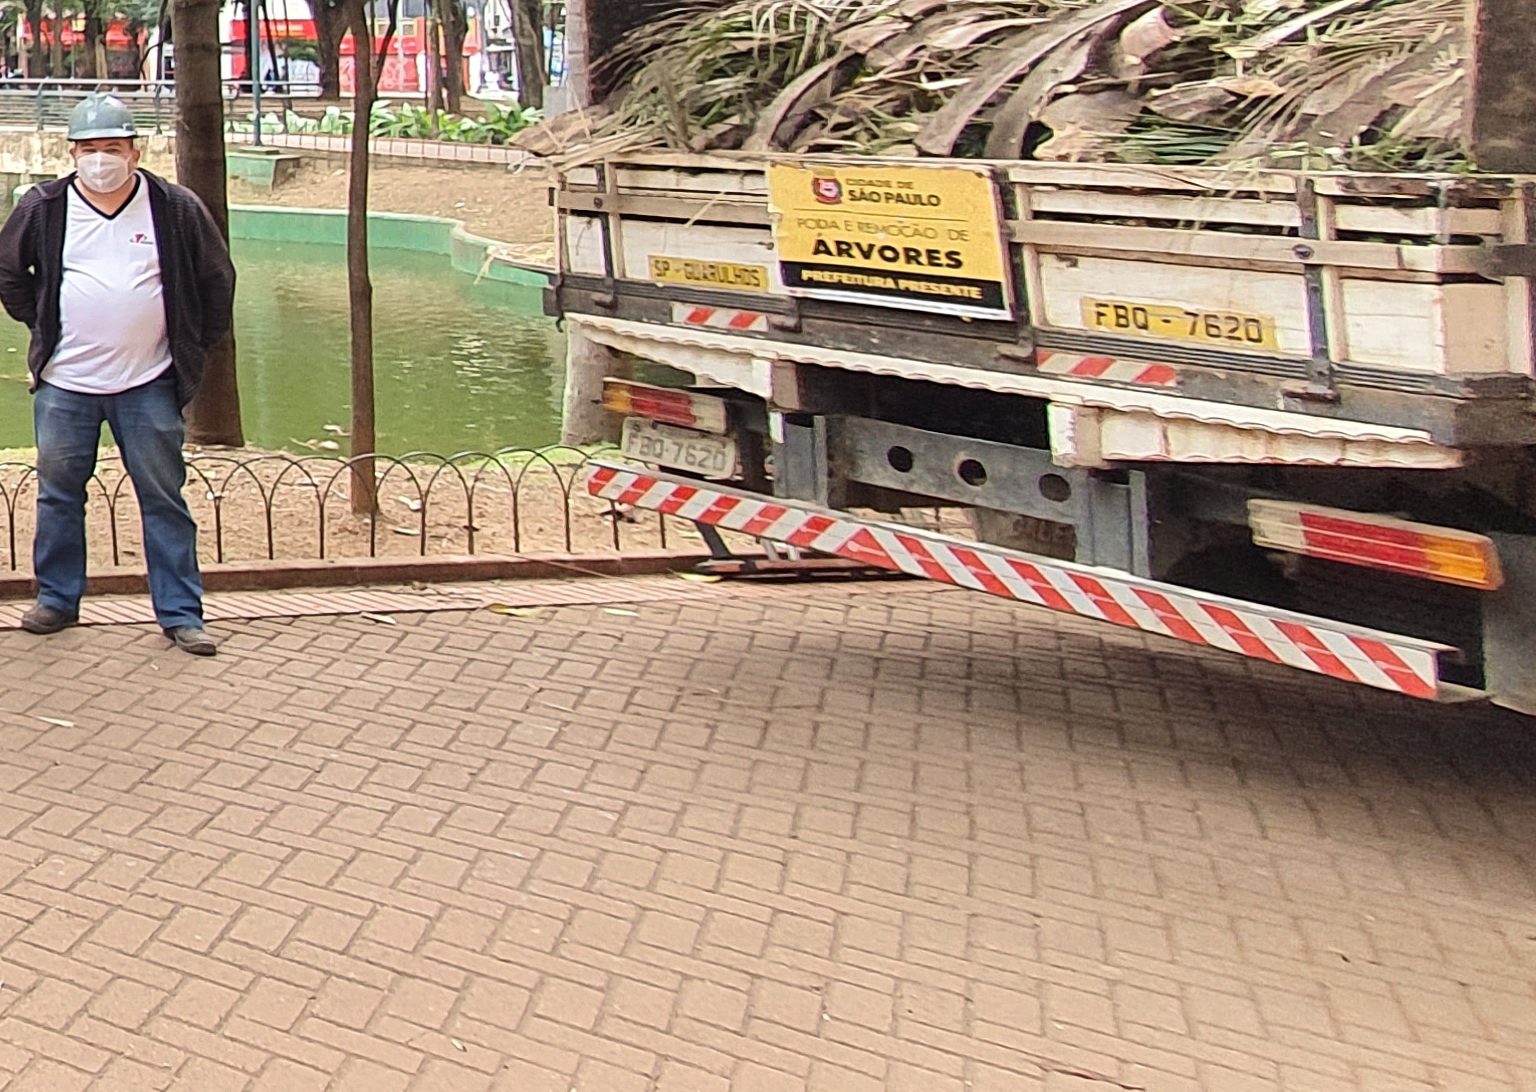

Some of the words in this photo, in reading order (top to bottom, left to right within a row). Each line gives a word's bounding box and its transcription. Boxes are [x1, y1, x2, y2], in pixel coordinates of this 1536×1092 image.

[845, 177, 893, 189] CIDADE
[898, 180, 914, 190] DE
[848, 188, 881, 203] SÃO
[885, 191, 941, 207] PAULO
[797, 217, 841, 231] PODA
[844, 219, 853, 232] E
[948, 228, 970, 242] DE
[812, 232, 964, 269] ÁRVORES
[654, 259, 670, 277] SP
[800, 268, 897, 291] PREFEITURA
[897, 279, 983, 299] PRESENTE
[1094, 302, 1149, 331] FBQ
[1183, 311, 1263, 344] 7620
